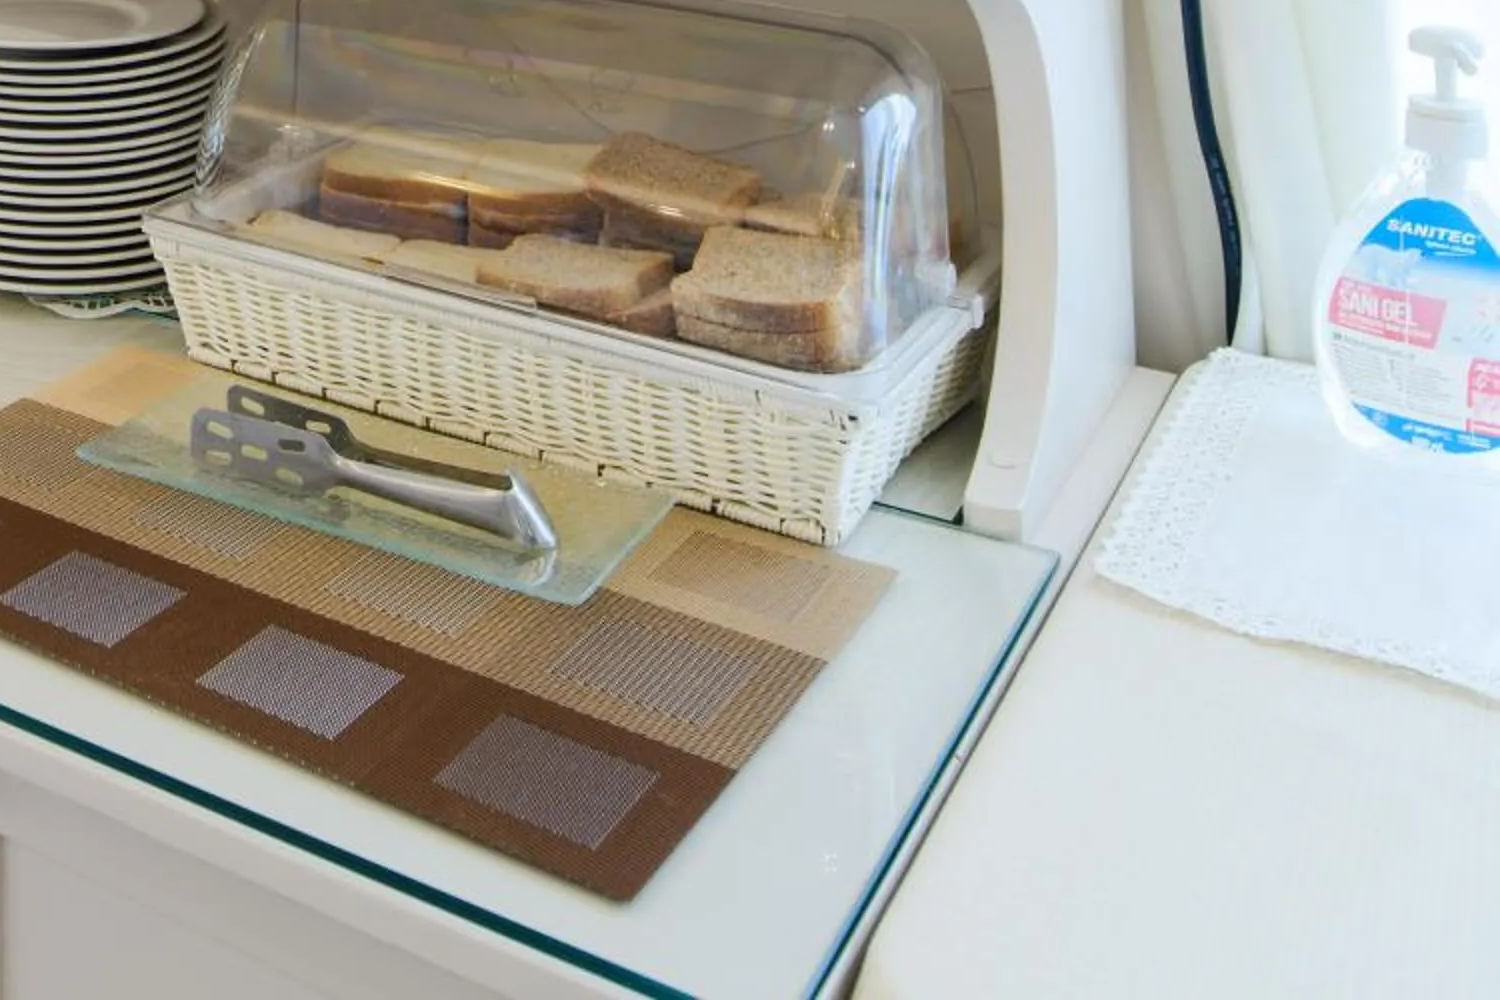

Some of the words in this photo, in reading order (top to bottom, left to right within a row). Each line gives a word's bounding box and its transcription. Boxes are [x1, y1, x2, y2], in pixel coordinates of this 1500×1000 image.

[1386, 218, 1476, 246] SANITEC
[1337, 289, 1378, 318] SANI
[1381, 298, 1414, 324] GEL
